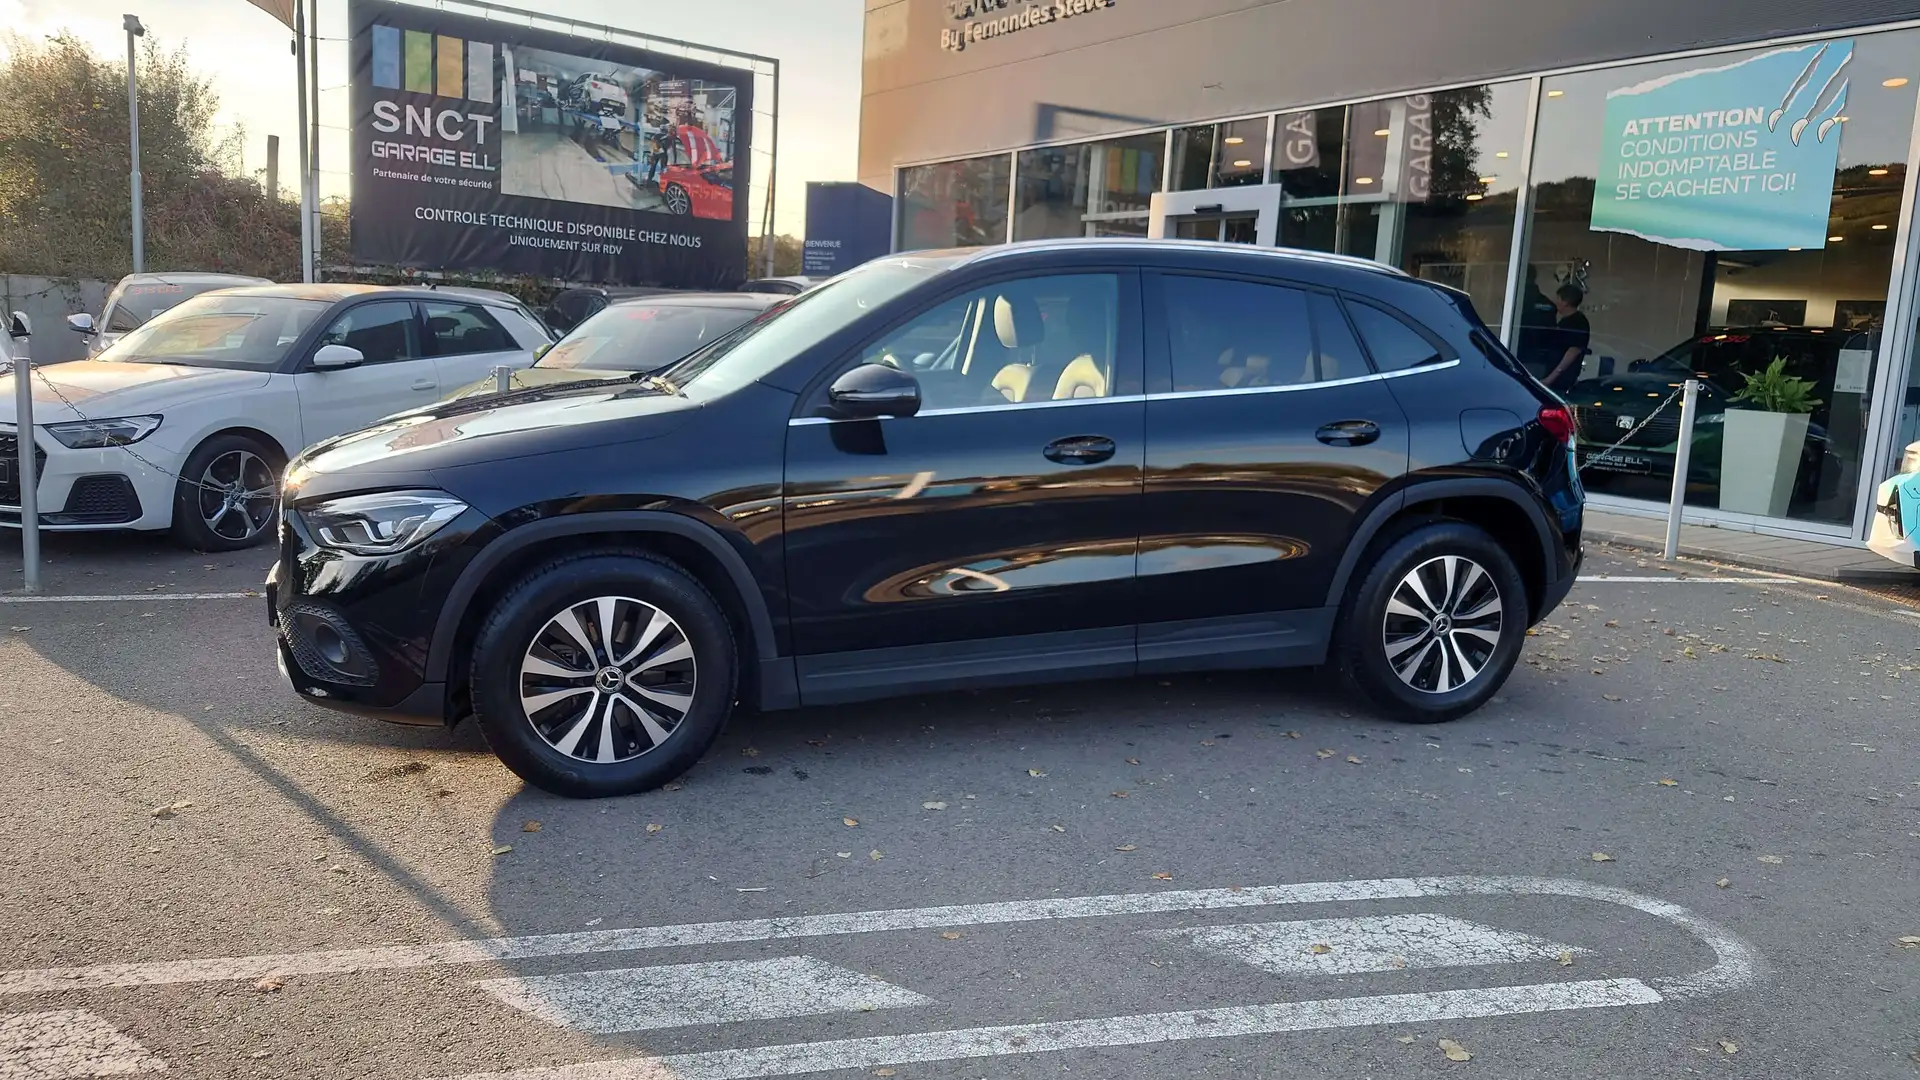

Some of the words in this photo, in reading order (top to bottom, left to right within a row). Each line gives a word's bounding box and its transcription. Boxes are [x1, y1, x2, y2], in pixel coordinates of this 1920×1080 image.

[941, 29, 960, 50] By
[964, 4, 1051, 42] Fernandes
[372, 100, 494, 145] SNCT
[1621, 106, 1765, 137] ATTENTION
[371, 140, 456, 167] GARAGE
[459, 151, 496, 172] ELL
[1620, 130, 1758, 158] CONDITIONS
[373, 168, 419, 181] Partenaire
[420, 174, 432, 183] de
[433, 177, 457, 186] votre
[458, 178, 493, 189] sécurité
[1617, 150, 1778, 180] INDOMPTABLE
[1614, 183, 1642, 201] SE
[1646, 175, 1756, 198] CACHENT
[1761, 172, 1796, 193] ICI!
[415, 207, 487, 226] CONTROLE
[490, 214, 564, 233] TECHNIQUE
[567, 222, 636, 241] DISPONIBLE
[638, 230, 668, 245] CHEZ
[669, 234, 702, 248] NOUS
[510, 235, 580, 251] UNIQUEMENT
[581, 242, 600, 253] SUR
[603, 246, 622, 255] RDV
[805, 240, 841, 248] BIENVENUE
[1625, 456, 1643, 465] ELL
